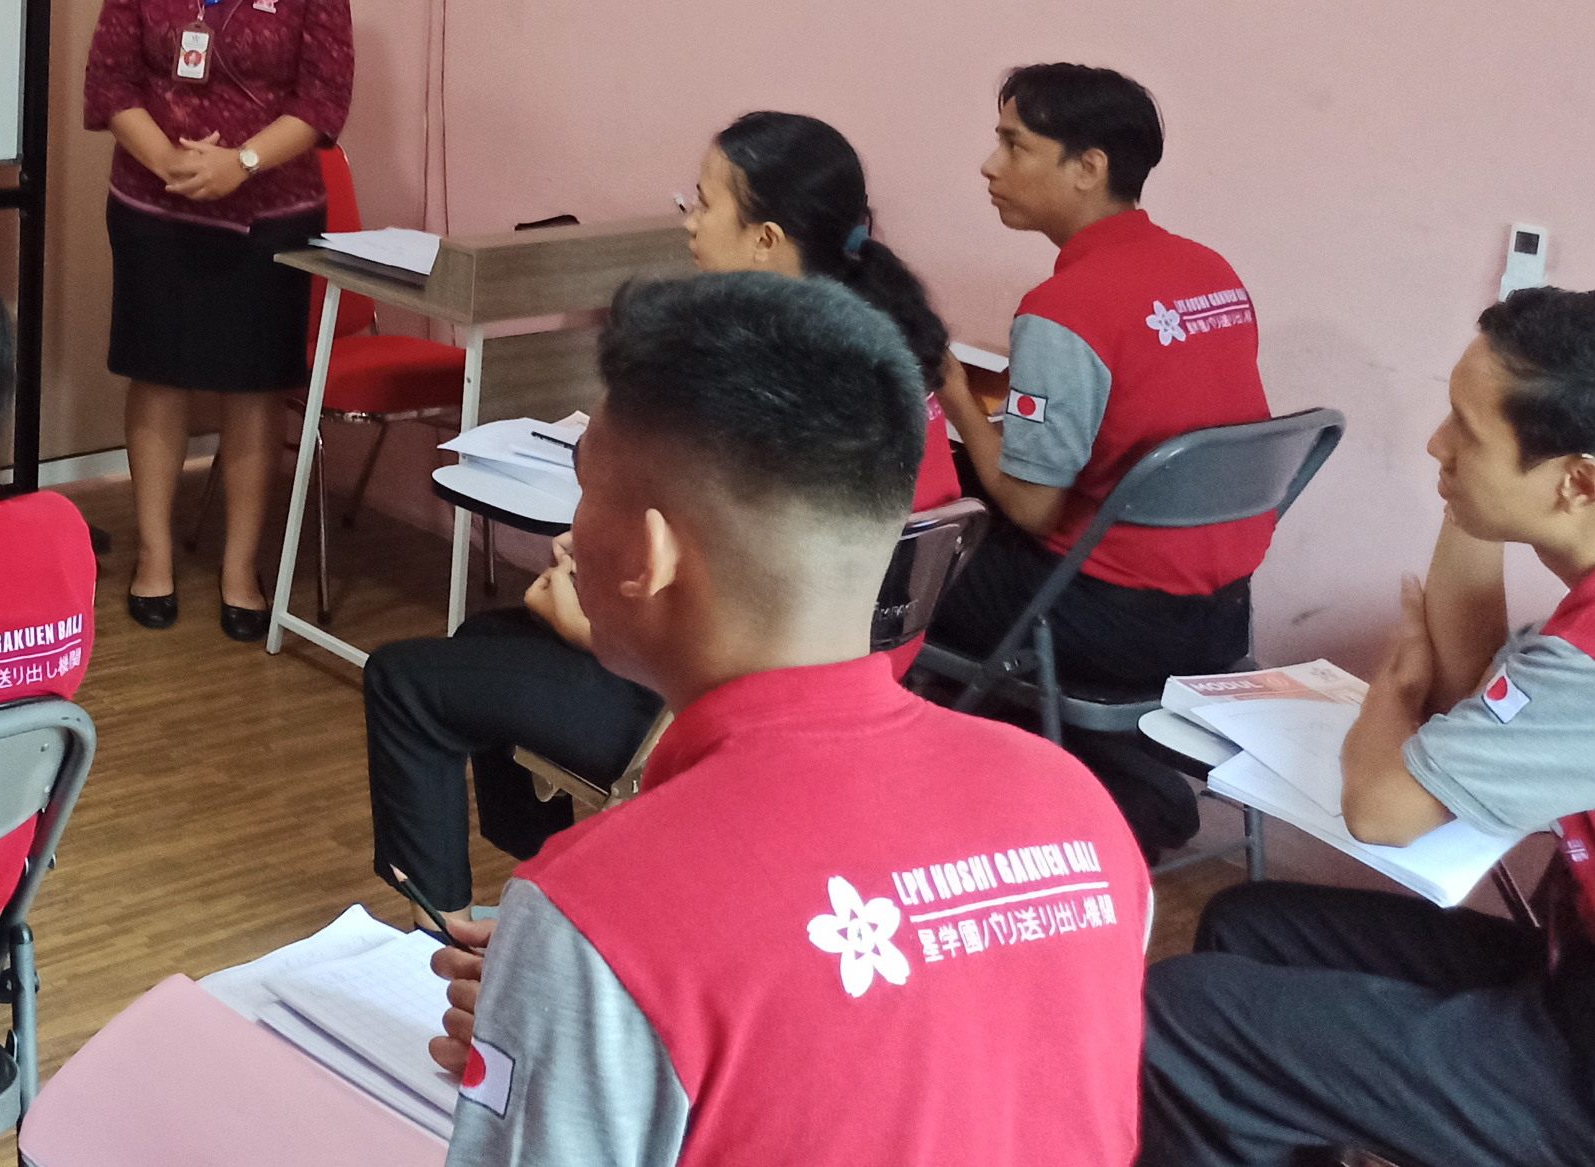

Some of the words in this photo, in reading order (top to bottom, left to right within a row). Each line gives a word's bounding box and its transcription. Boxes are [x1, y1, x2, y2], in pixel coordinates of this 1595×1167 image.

[57, 613, 83, 641] BALI
[1191, 680, 1264, 693] MODUL
[892, 867, 935, 905] LPK
[929, 854, 998, 900] HOSHI
[994, 843, 1070, 884] GAKUEN
